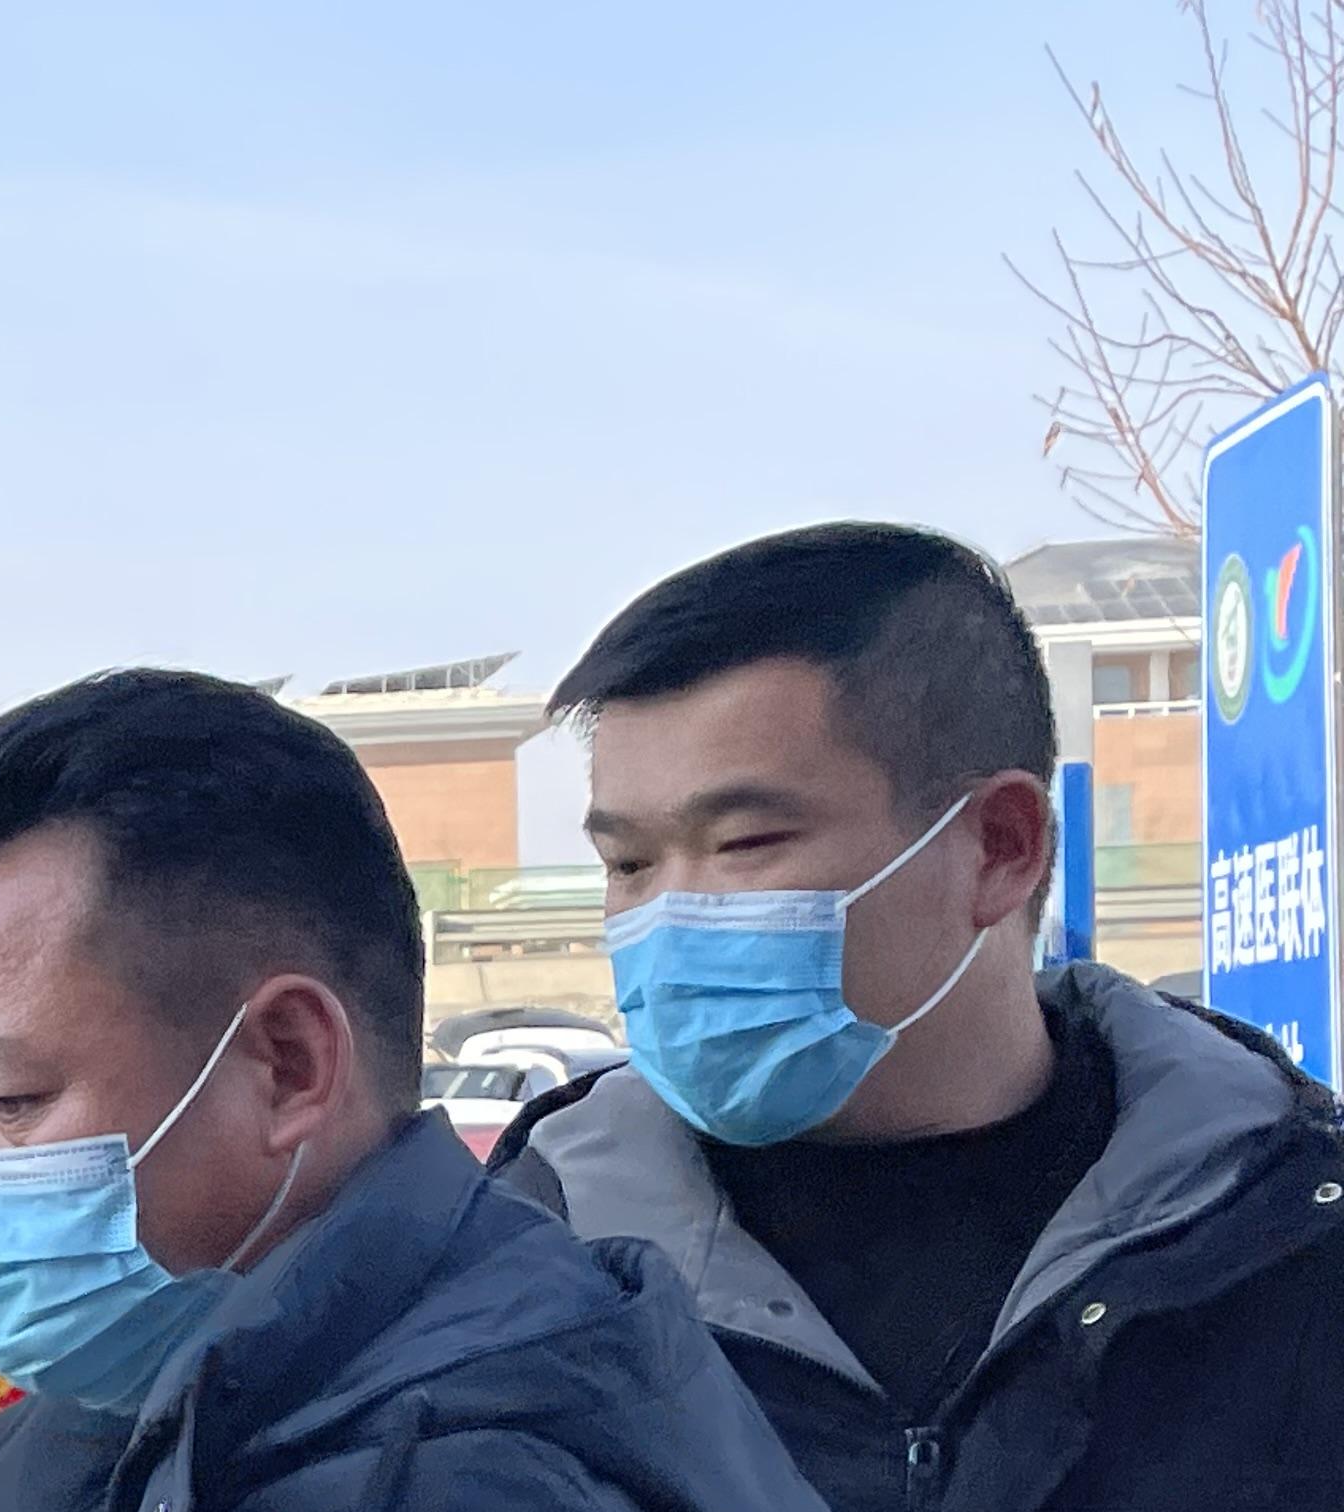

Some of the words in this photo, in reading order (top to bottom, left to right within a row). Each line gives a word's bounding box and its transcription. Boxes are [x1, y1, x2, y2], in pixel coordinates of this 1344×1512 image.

[1210, 825, 1326, 976] 高速医联体
